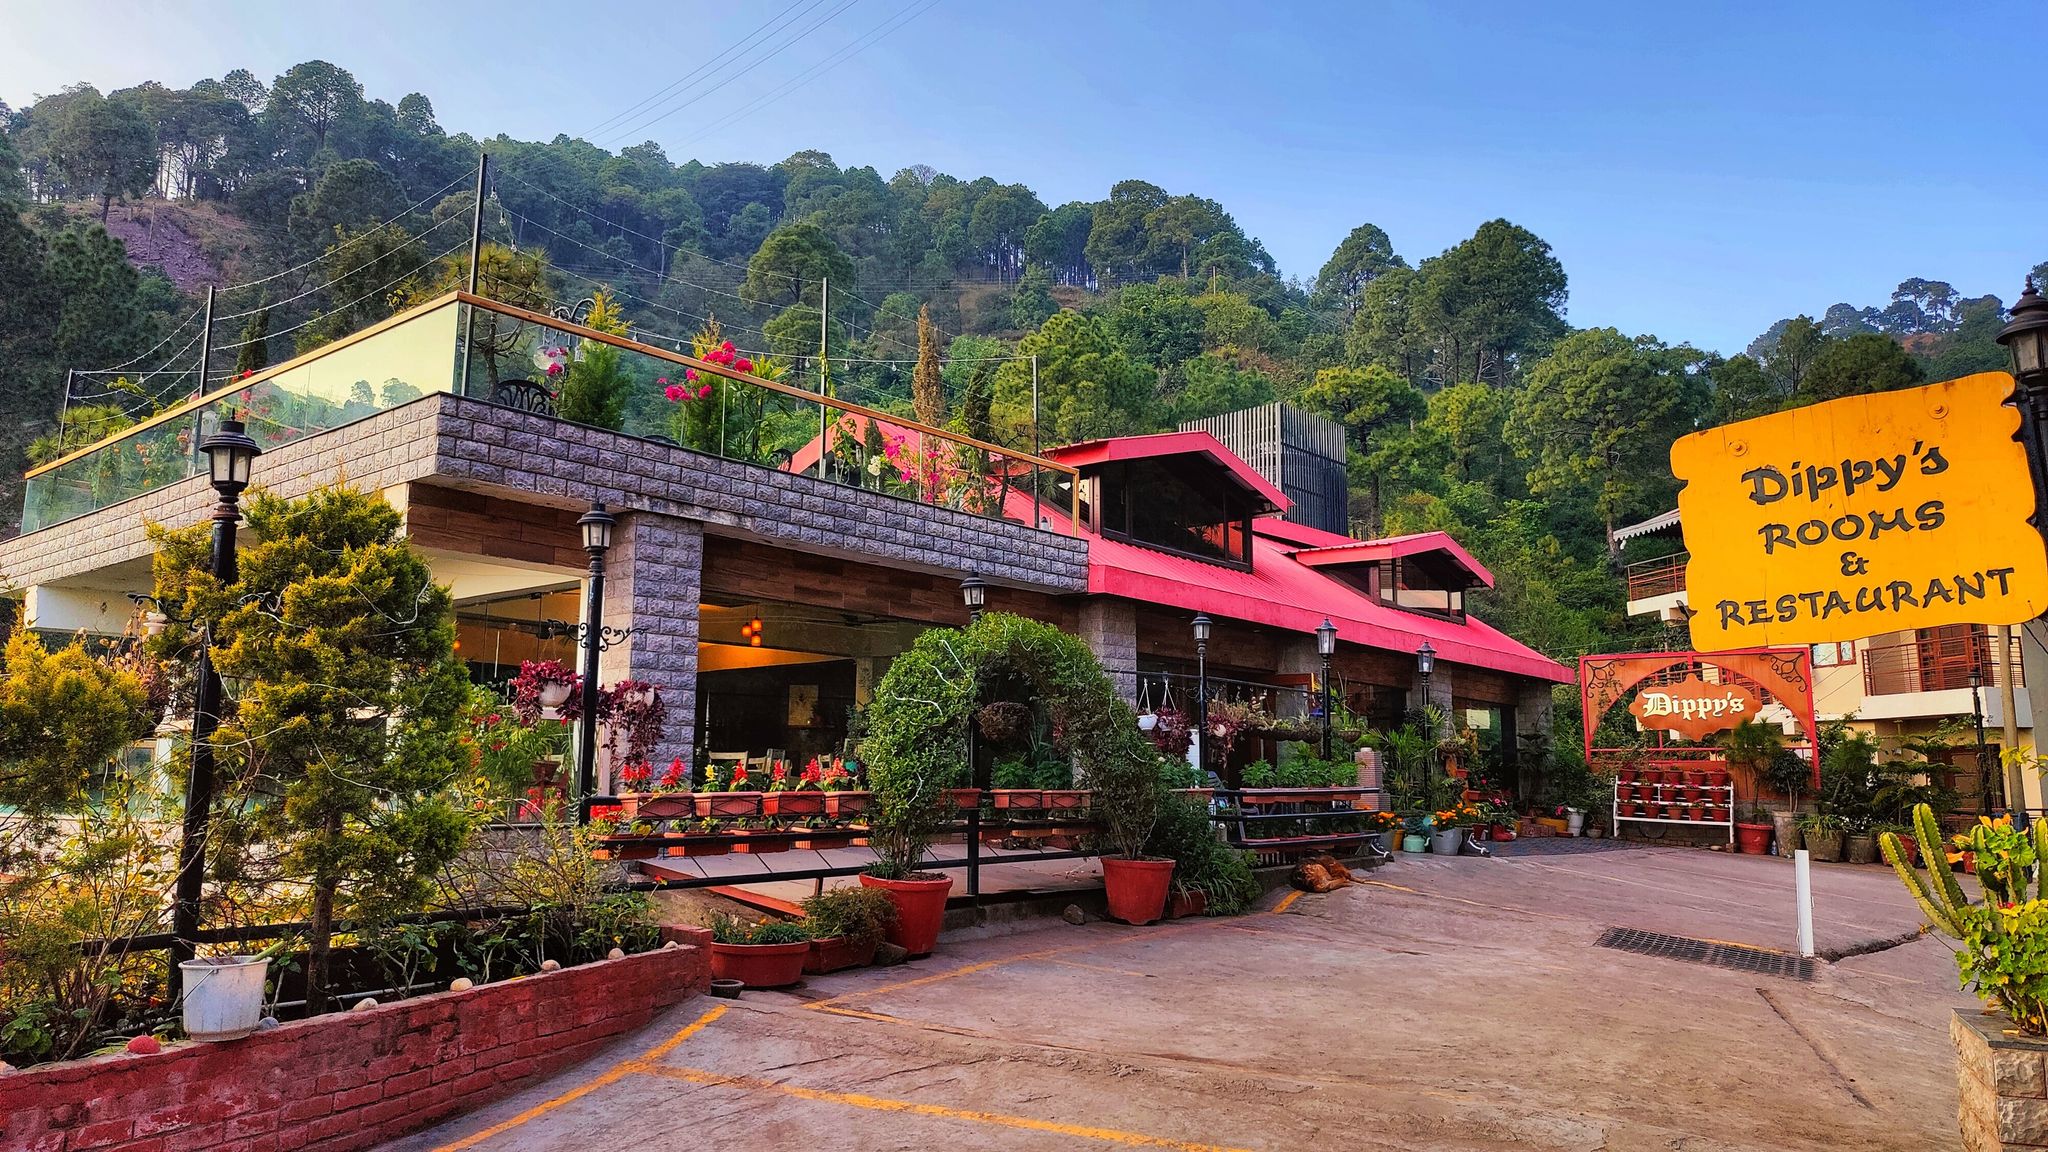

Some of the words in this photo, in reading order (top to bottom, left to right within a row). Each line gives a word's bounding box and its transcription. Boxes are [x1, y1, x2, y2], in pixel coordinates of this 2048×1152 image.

[1740, 440, 1949, 505] Dippy's
[1758, 500, 1946, 555] ROOMS
[1840, 551, 1870, 576] &
[1715, 567, 2015, 631] RESTAURANT
[1642, 691, 1745, 721] Dippy's
